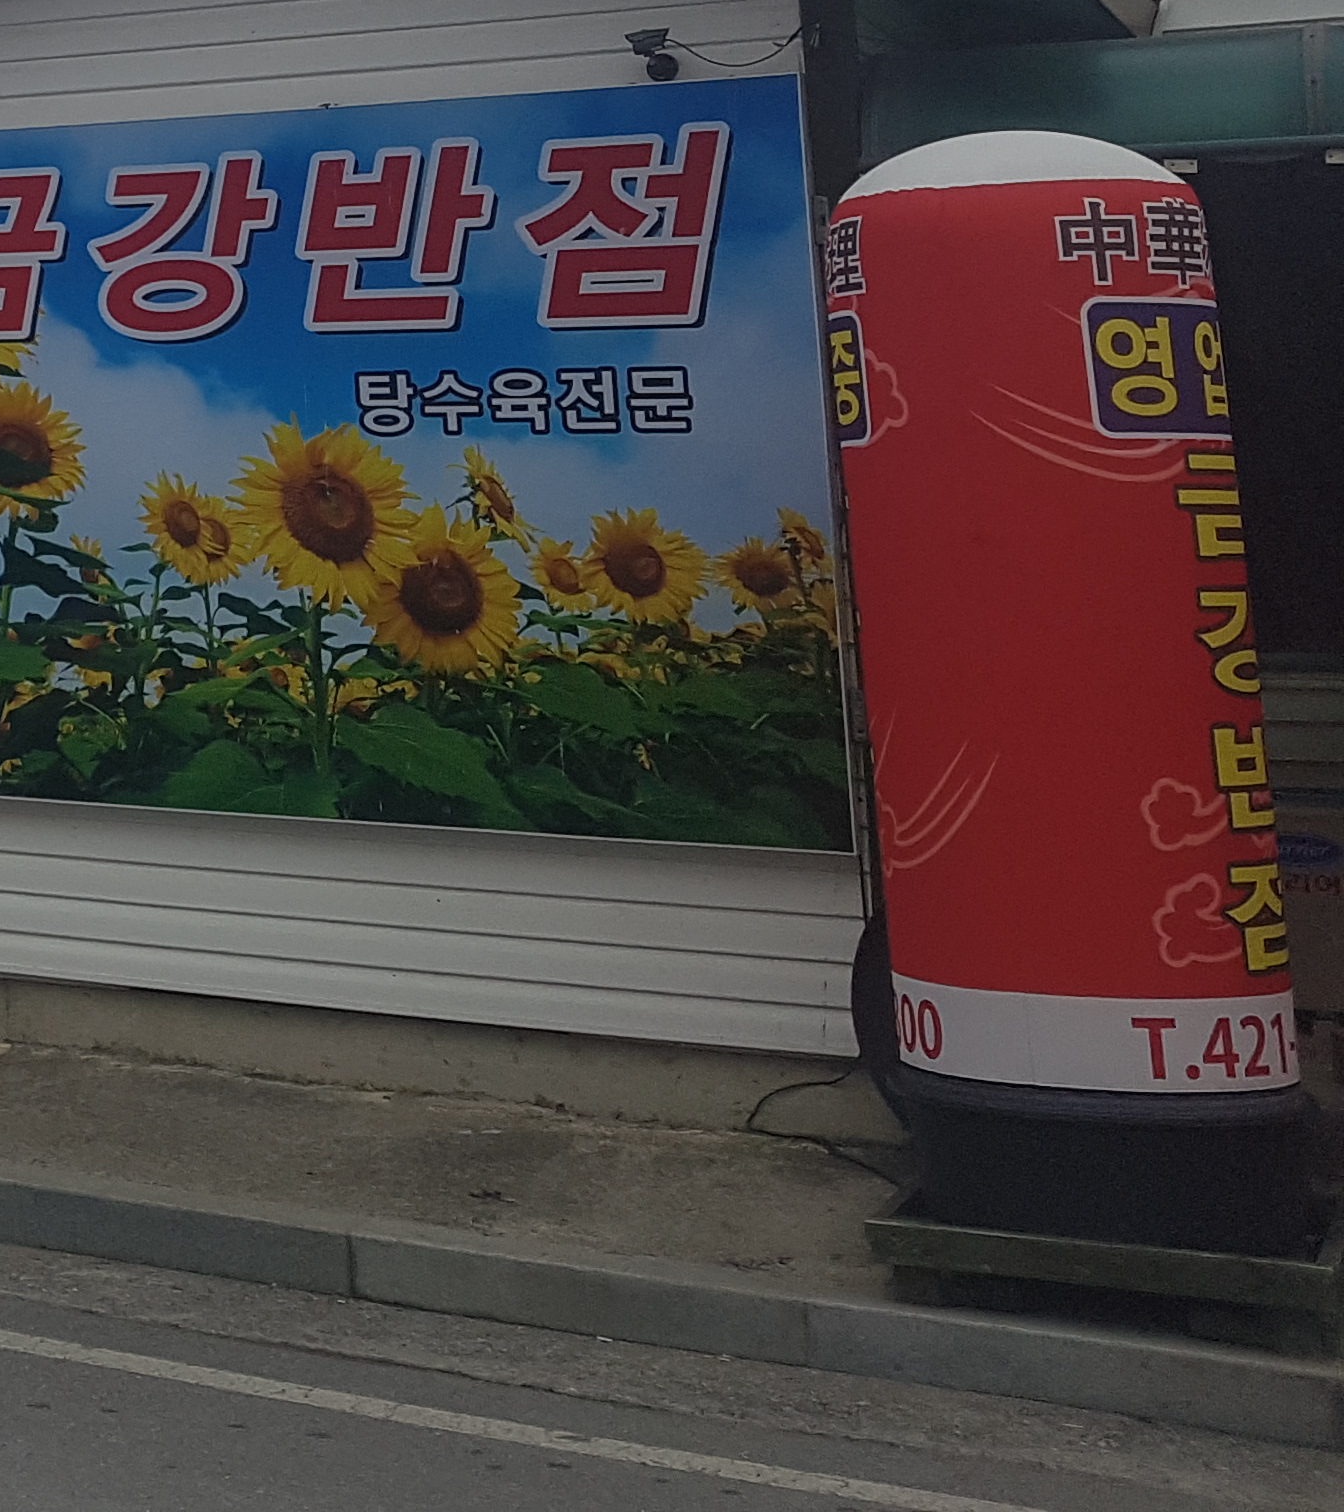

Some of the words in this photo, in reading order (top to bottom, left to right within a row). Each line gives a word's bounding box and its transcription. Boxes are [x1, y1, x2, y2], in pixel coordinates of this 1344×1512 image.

[1054, 197, 1206, 290] 中華
[356, 365, 693, 435] 탕수육전문
[894, 993, 943, 1059] 00
